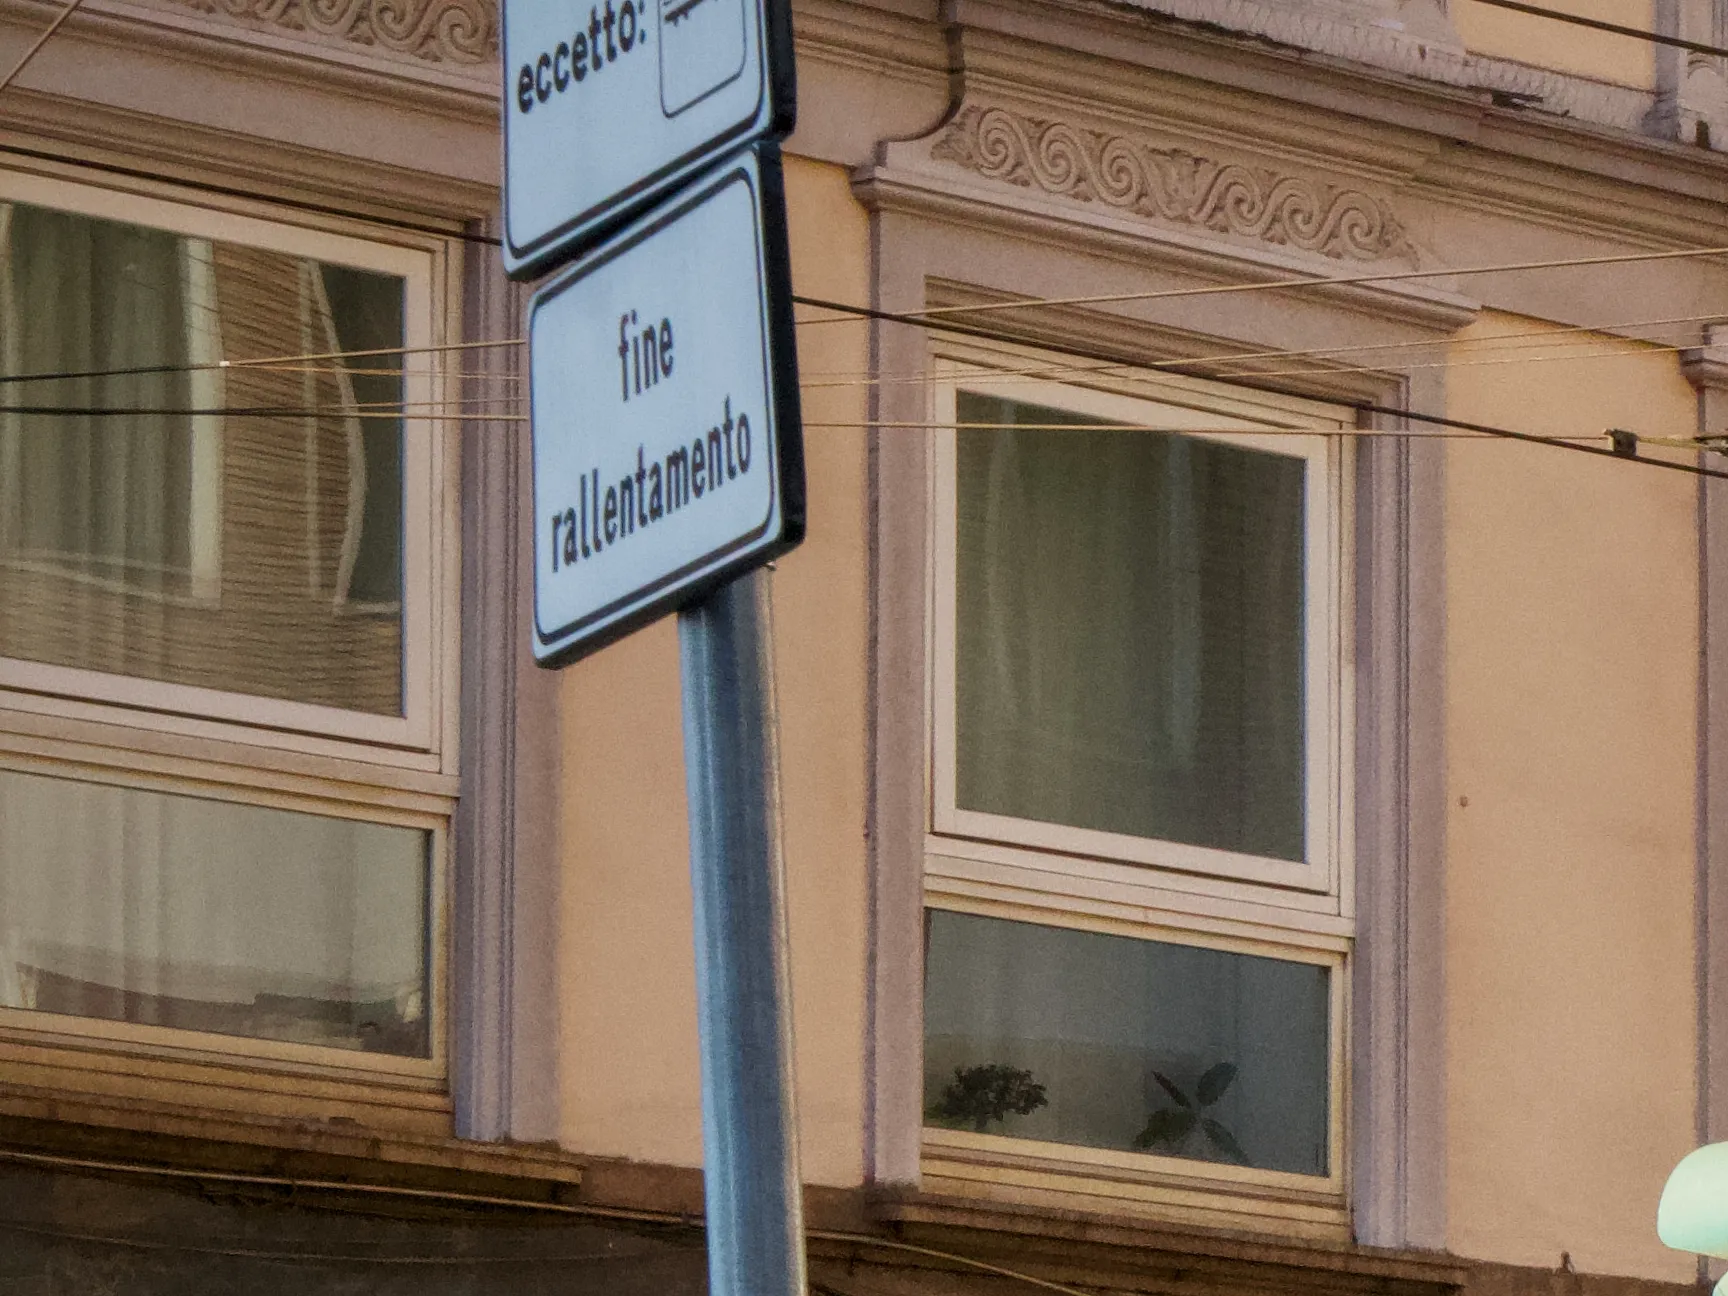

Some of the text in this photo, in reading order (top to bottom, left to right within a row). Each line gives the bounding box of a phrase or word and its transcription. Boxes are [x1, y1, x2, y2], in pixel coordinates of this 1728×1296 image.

[517, 0, 646, 114] eccetto:
[617, 310, 675, 403] fine
[552, 393, 752, 574] rallentamento
